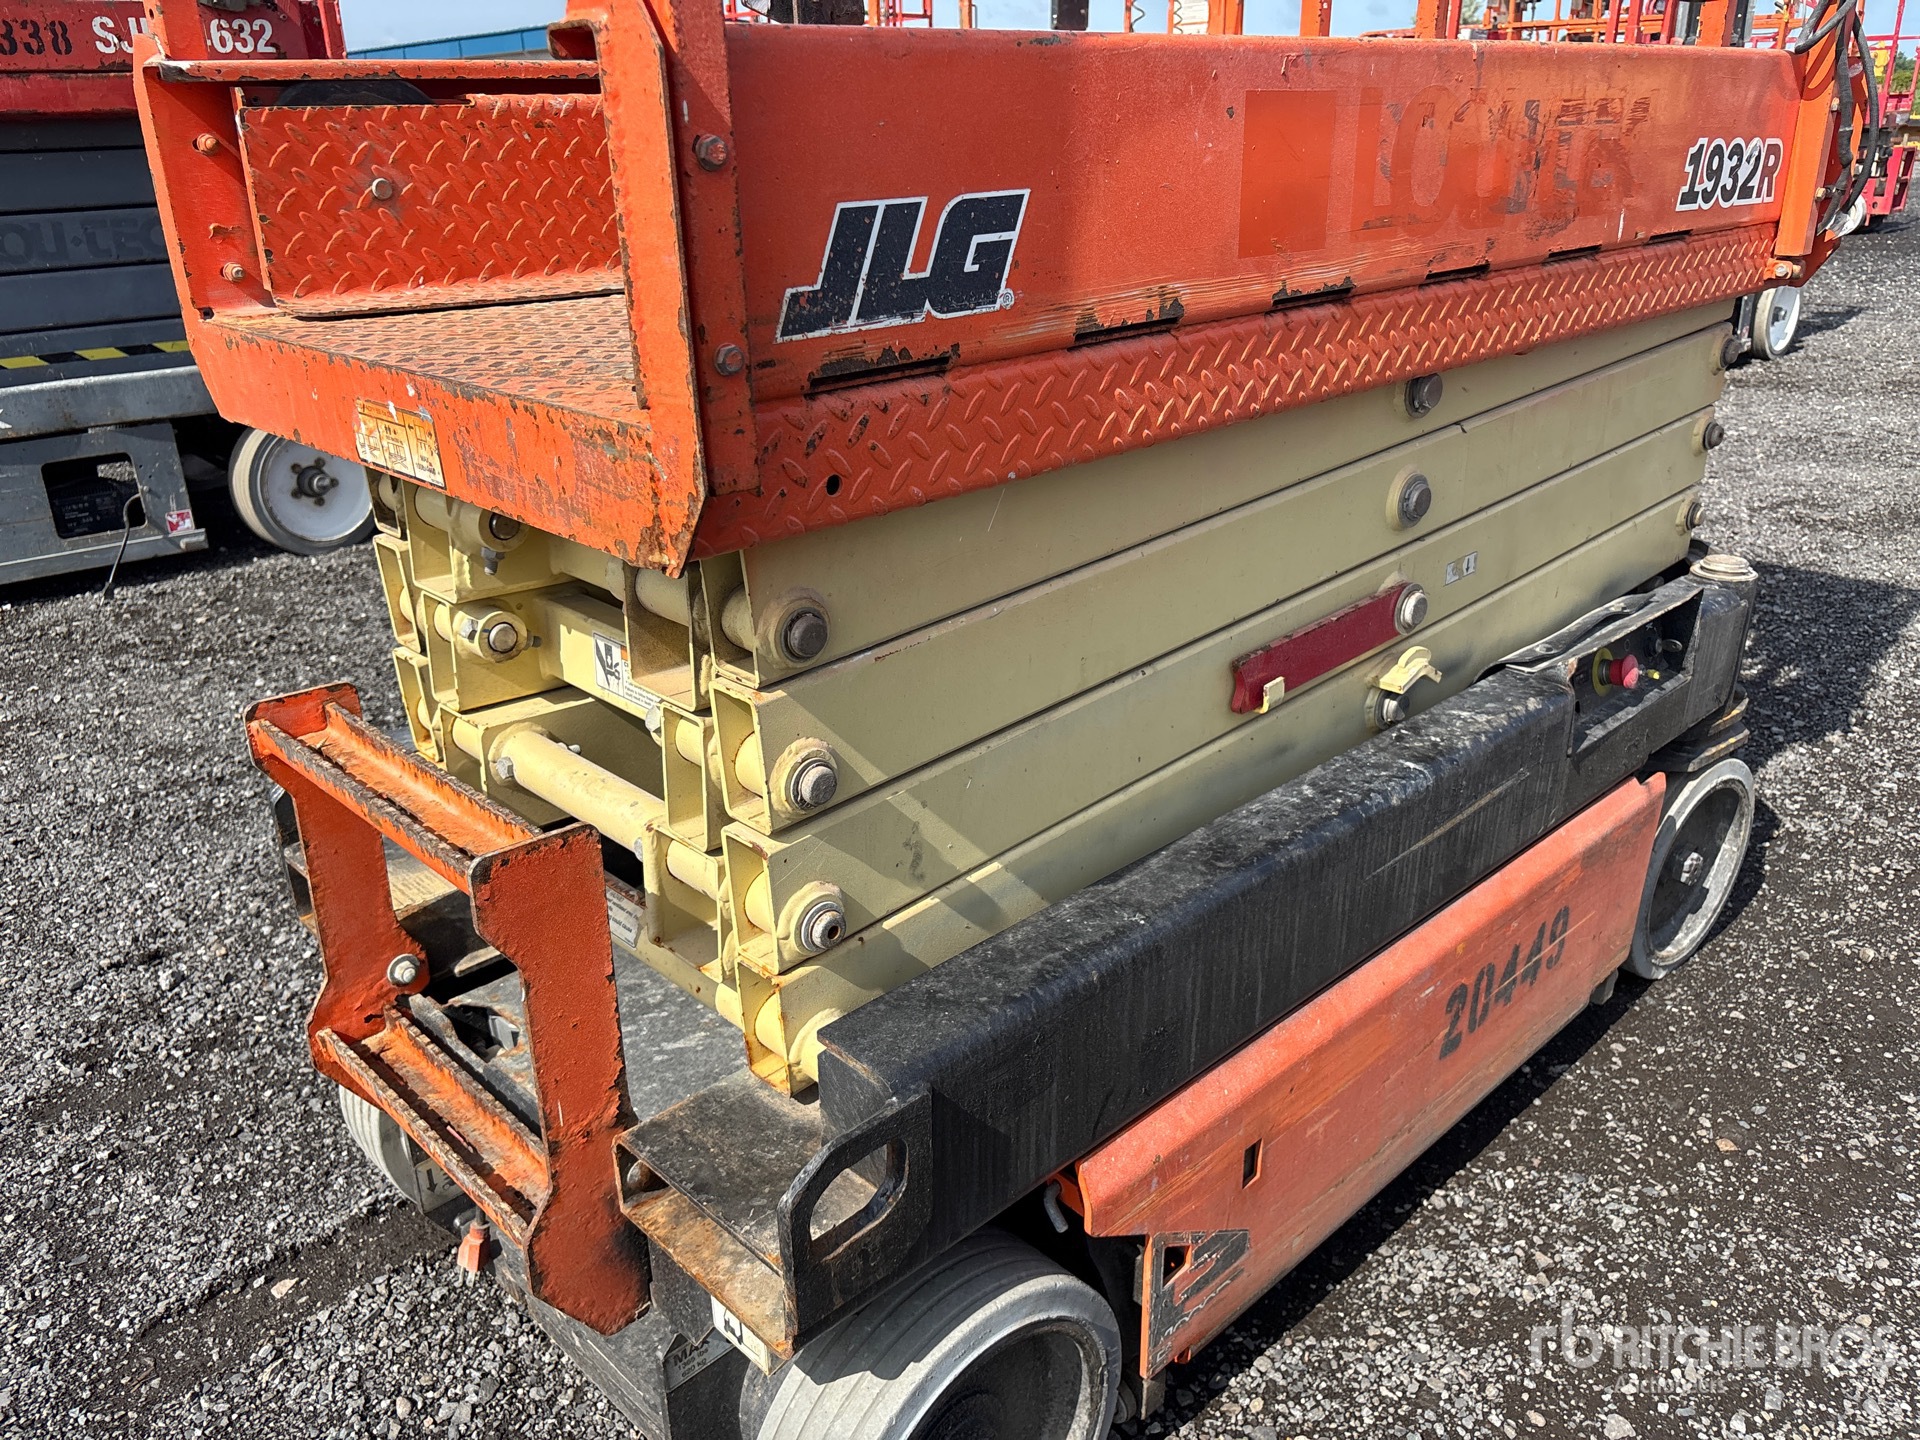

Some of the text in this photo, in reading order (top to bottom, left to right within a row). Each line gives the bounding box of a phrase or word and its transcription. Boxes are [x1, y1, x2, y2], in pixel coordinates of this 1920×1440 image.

[207, 19, 276, 53] 632
[1676, 137, 1783, 211] 1932R
[774, 188, 1031, 344] JLG
[1438, 905, 1570, 1060] 20449
